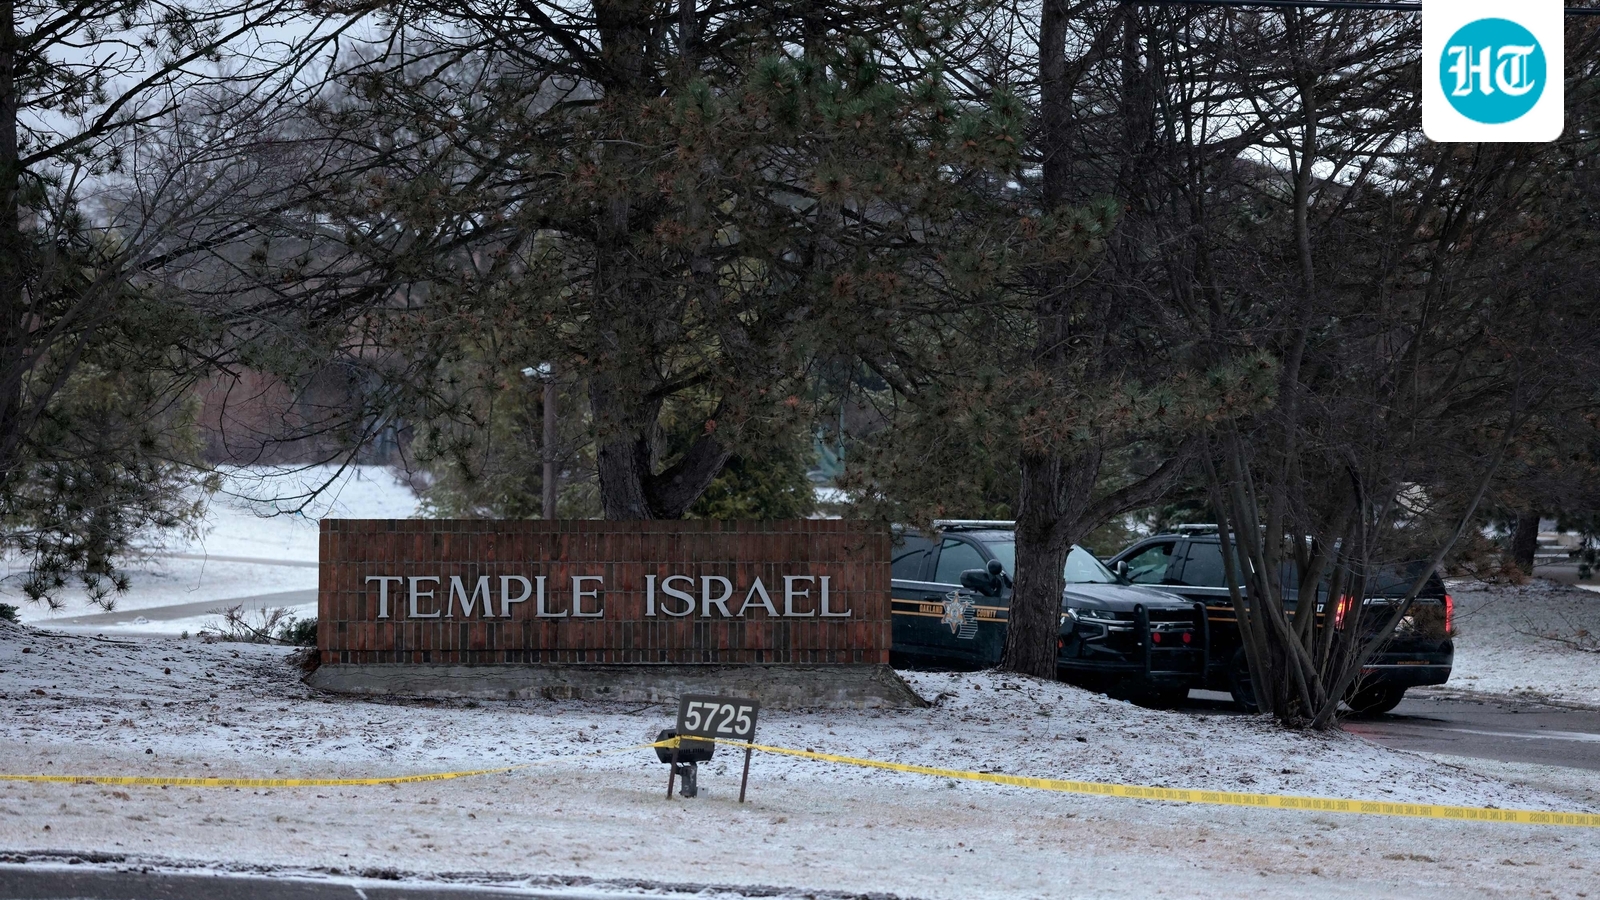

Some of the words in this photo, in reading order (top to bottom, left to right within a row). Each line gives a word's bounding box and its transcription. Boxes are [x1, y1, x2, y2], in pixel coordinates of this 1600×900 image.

[365, 575, 604, 619] TEMPLE
[645, 574, 852, 618] ISRAEL
[919, 604, 943, 614] OAKLAND
[976, 609, 997, 618] COUNTY
[684, 701, 753, 735] 5725
